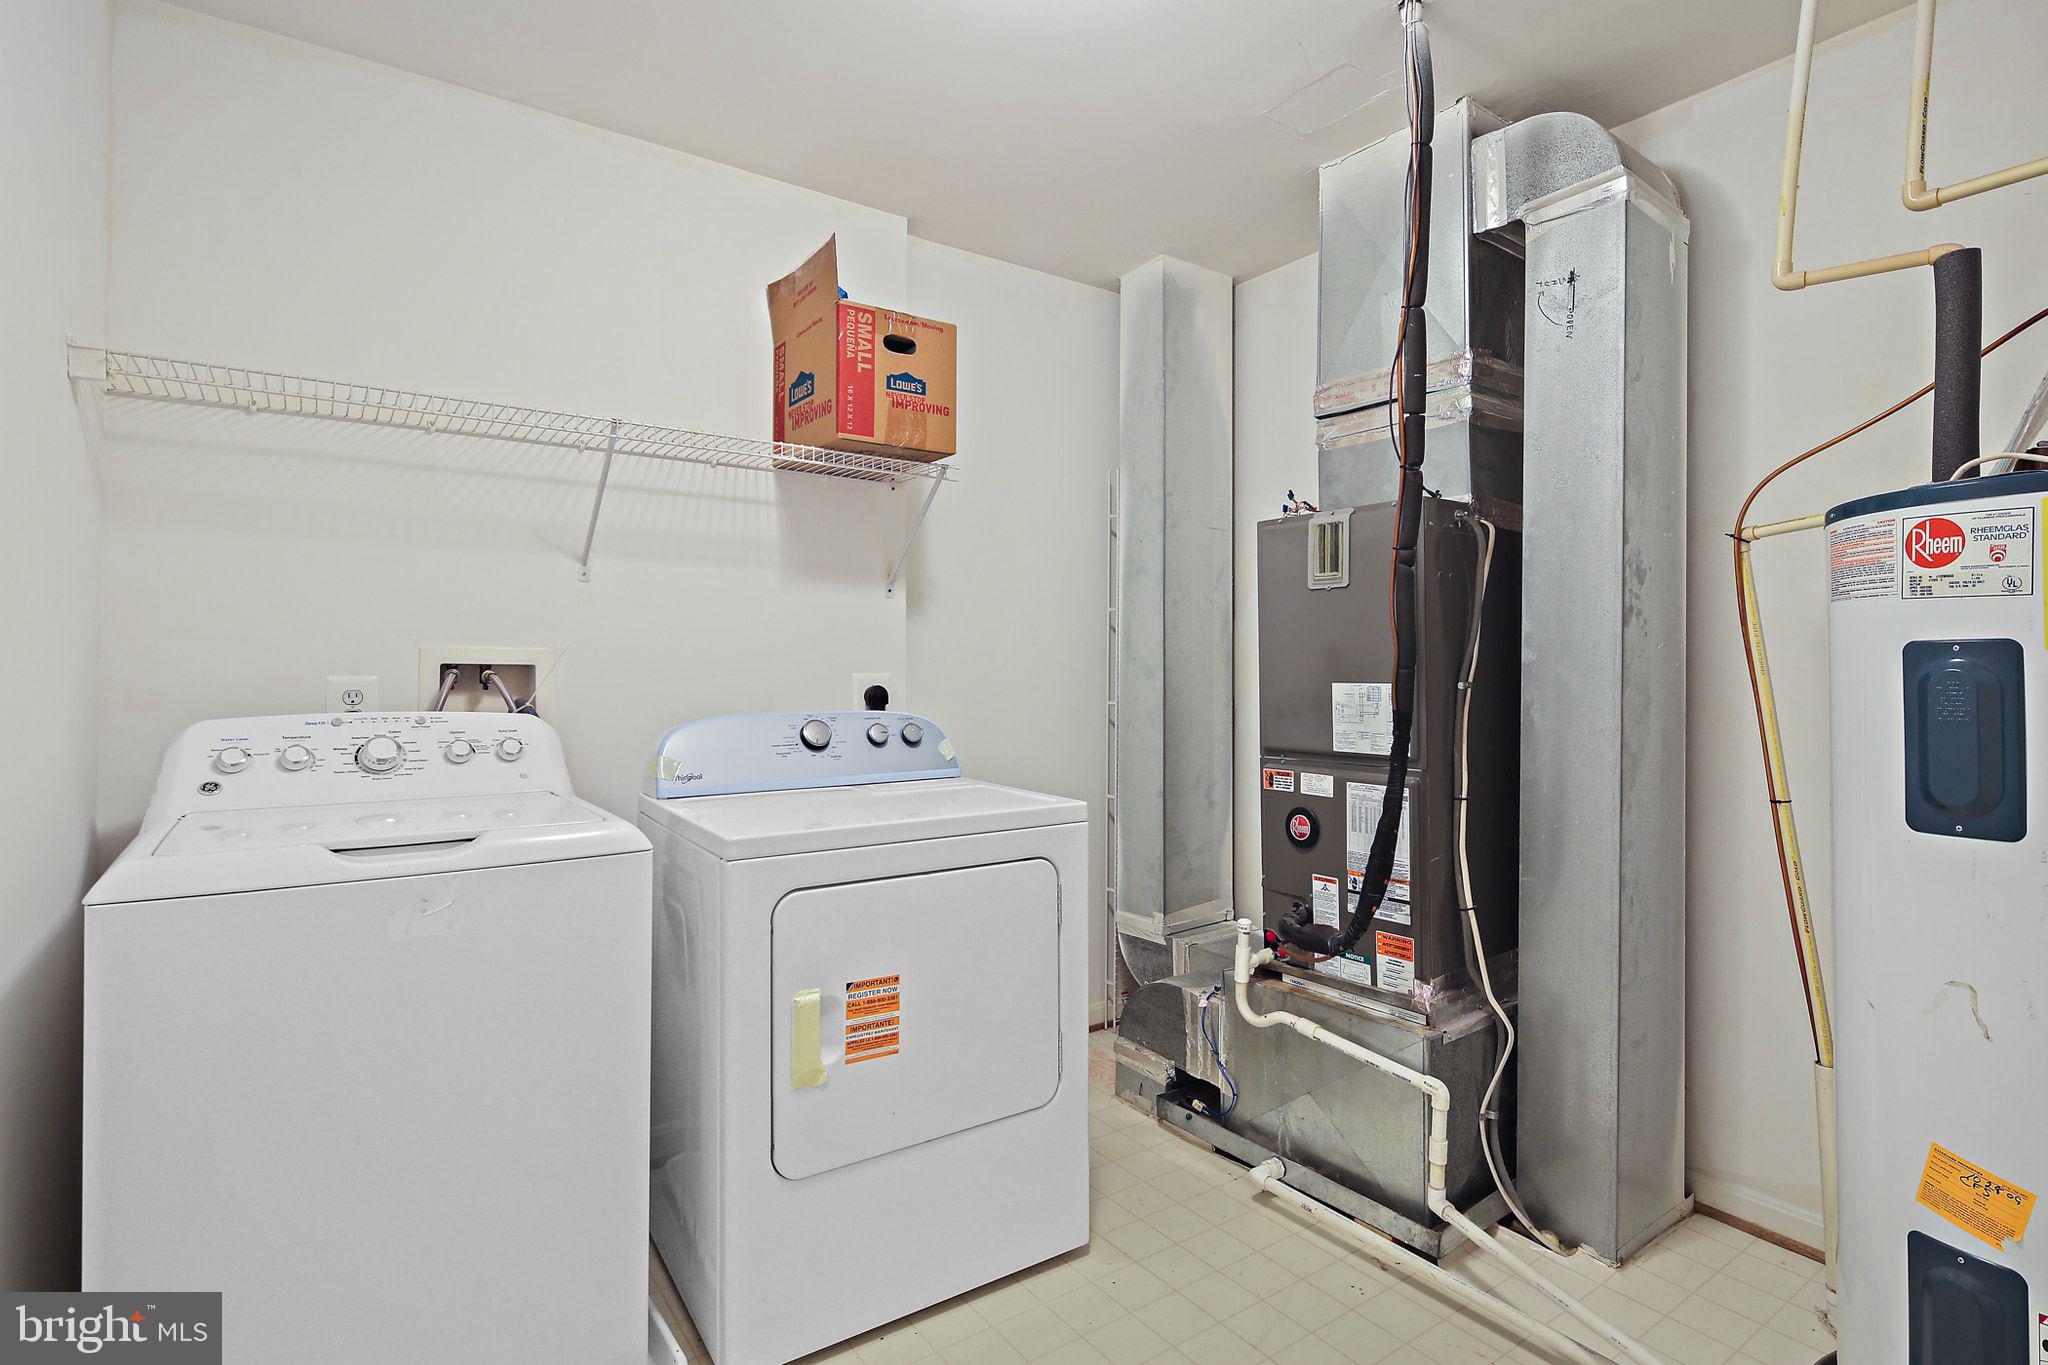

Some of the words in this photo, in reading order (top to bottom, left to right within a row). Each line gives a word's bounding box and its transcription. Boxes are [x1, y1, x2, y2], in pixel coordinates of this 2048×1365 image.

[857, 311, 873, 373] SMALL
[791, 379, 812, 403] LOWE'S
[890, 377, 923, 393] LOWE'S
[791, 398, 833, 431] IMPROVING
[891, 397, 950, 417] IMPROVING
[1970, 523, 2029, 535] RHEEMGLAS
[1973, 531, 2027, 542] STANDARD
[1912, 520, 1963, 562] Rheem
[1345, 952, 1364, 962] NOTICE
[848, 988, 882, 1000] REGISTER
[882, 986, 898, 995] NOW
